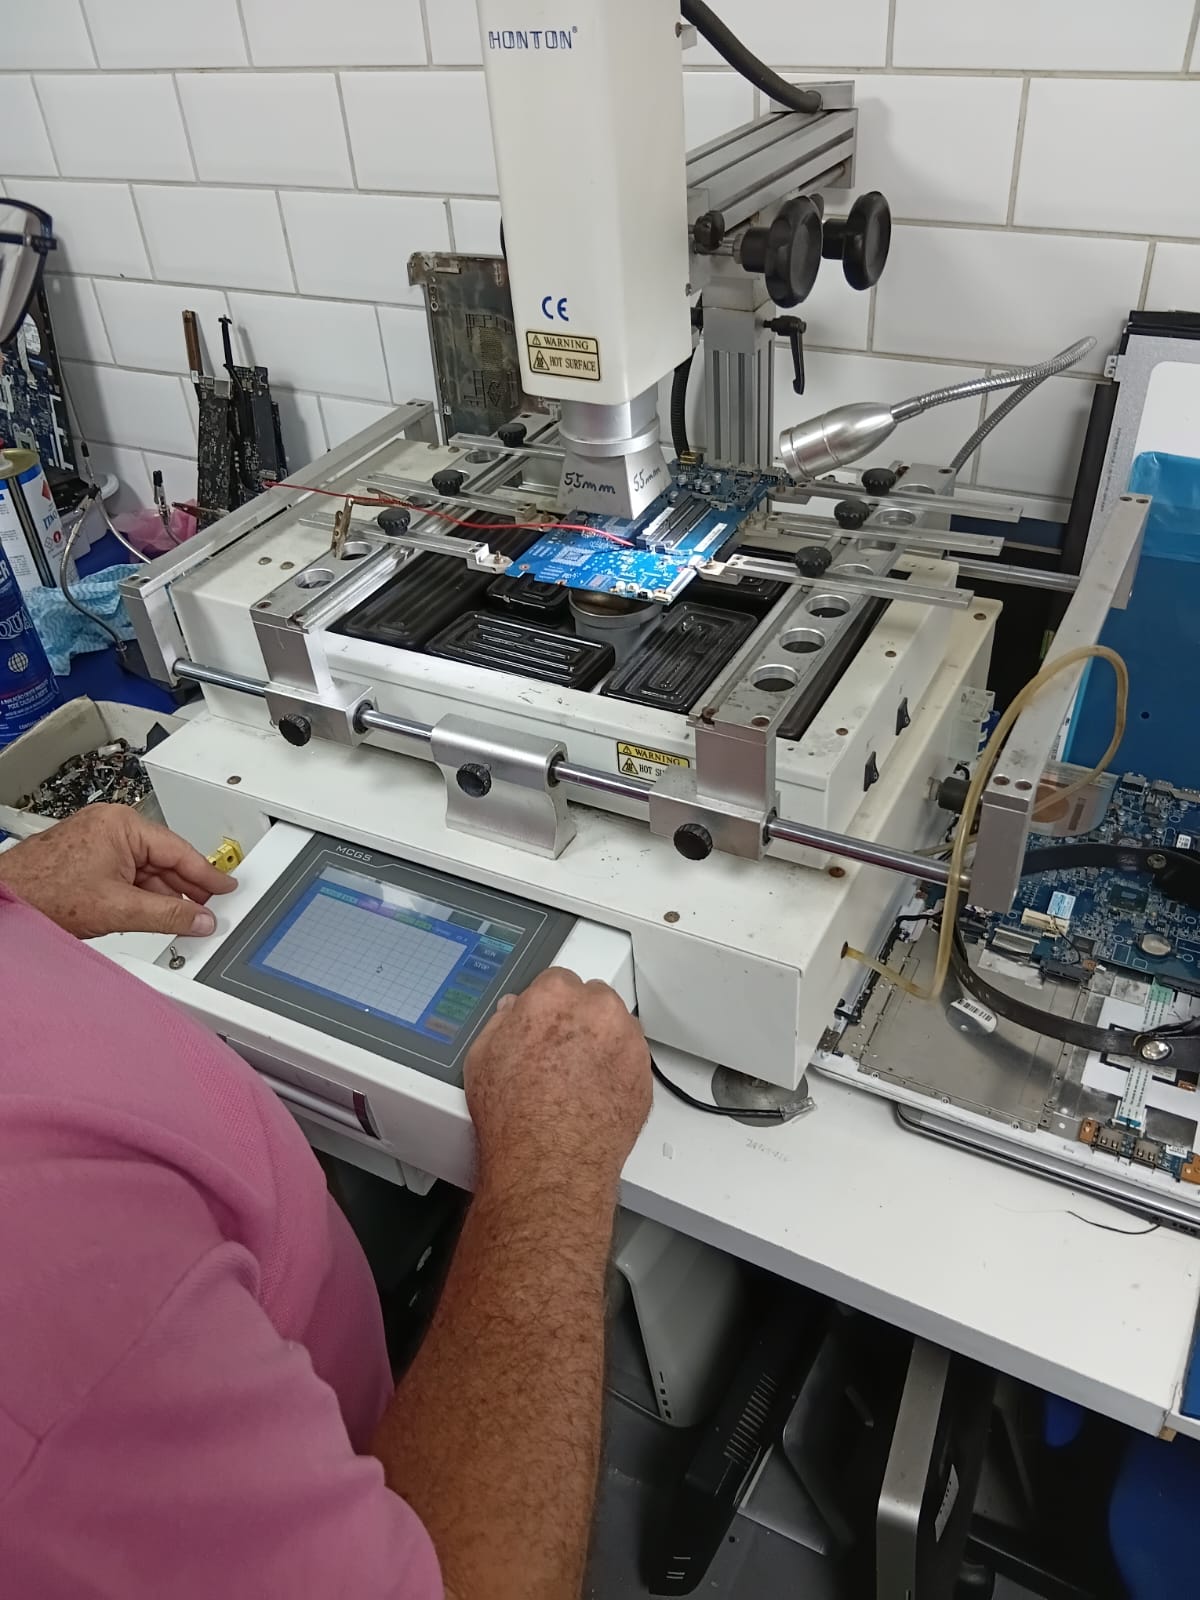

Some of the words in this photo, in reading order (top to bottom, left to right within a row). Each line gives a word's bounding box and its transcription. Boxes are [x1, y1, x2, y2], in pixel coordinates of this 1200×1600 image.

[488, 30, 572, 50] HONTON
[541, 296, 569, 321] CE
[543, 336, 589, 350] WARNING
[549, 356, 563, 368] HOT
[565, 357, 597, 372] SURFACE
[634, 748, 681, 766] WARNING
[639, 764, 653, 775] HOT
[335, 845, 373, 862] MCGS
